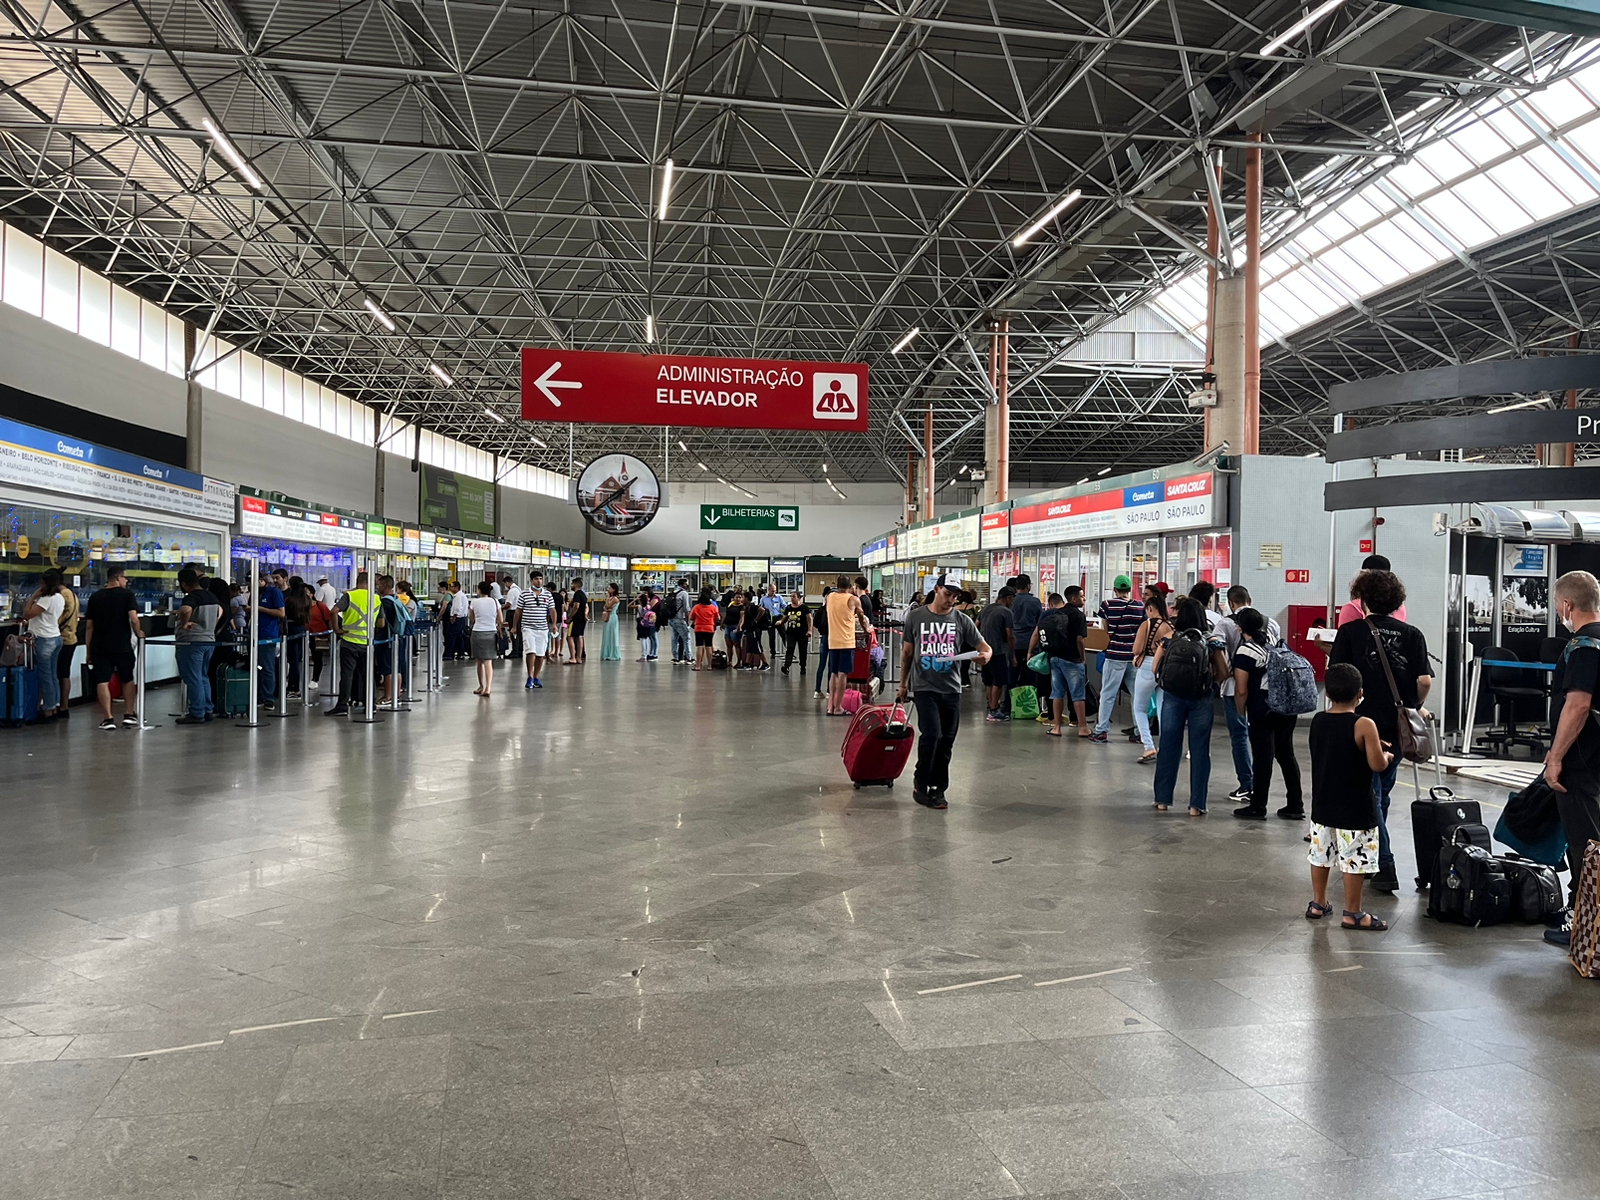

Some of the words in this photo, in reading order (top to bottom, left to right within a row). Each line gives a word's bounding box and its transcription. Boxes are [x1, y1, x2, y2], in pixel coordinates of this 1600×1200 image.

[657, 365, 804, 389] ADMINISTRAÇÃO
[656, 388, 758, 408] ELEVADOR
[1577, 415, 1600, 436] Pr
[57, 441, 84, 458] Cometa
[1152, 469, 1160, 480] 60
[1132, 490, 1155, 502] Cometa
[722, 508, 776, 518] BILHETERIAS
[1127, 512, 1139, 524] SÃO
[1140, 510, 1160, 522] PAULO
[1167, 506, 1181, 519] SÃO
[1182, 503, 1205, 517] PAULO
[1299, 571, 1308, 582] H
[920, 622, 956, 635] LIVE
[921, 633, 955, 644] LOVE
[920, 643, 955, 655] LAUGH
